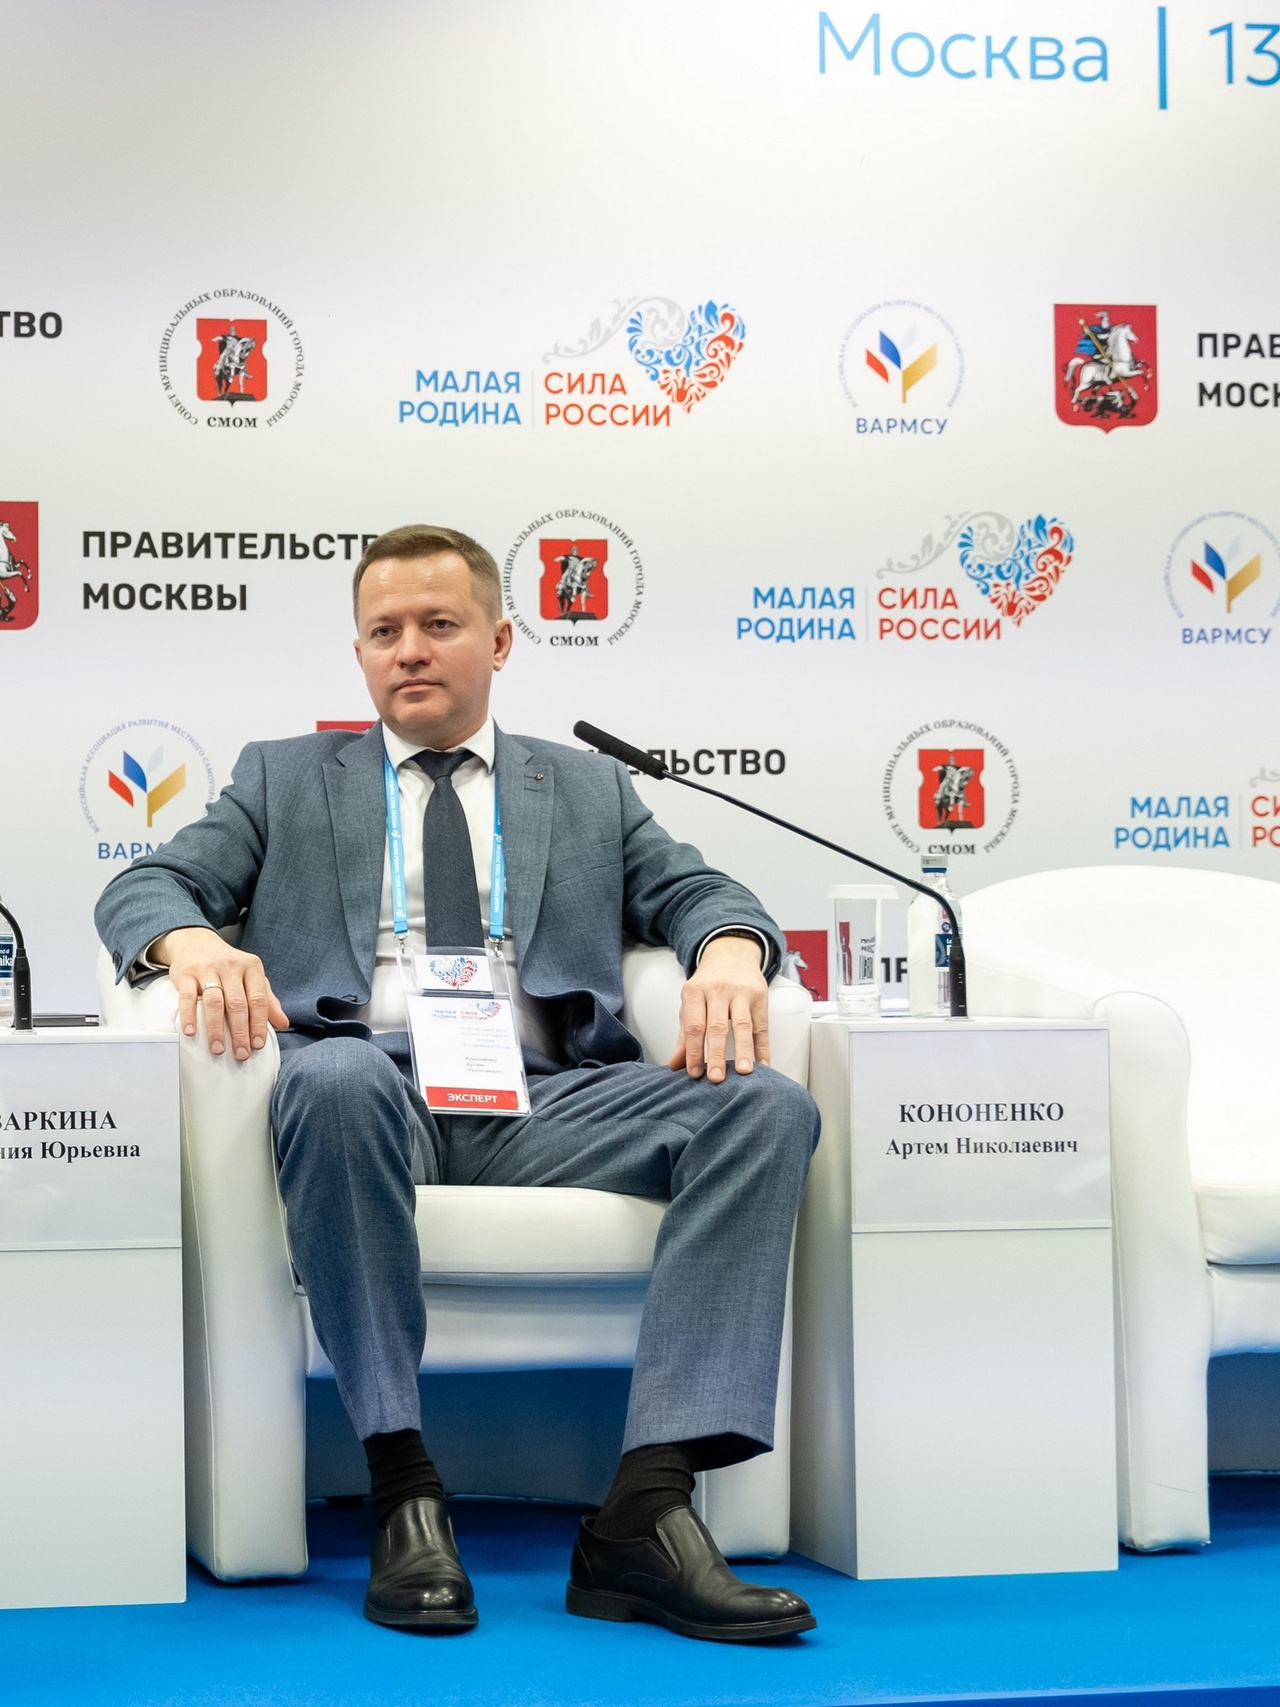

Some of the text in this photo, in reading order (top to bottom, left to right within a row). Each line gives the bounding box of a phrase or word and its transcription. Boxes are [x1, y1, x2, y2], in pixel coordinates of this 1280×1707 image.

[818, 11, 1109, 83] Москва
[1208, 22, 1280, 87] 13
[159, 288, 305, 427] СОВЕТ МУНИЦИПАЛЬНЫХ ОБРАЗОВАНИЙ ГОРОДА МОСКВЫ
[416, 369, 521, 394] МАЛАЯ
[543, 371, 627, 396] СИЛА
[206, 416, 258, 428] СМОМ
[399, 400, 522, 427] РОДИНА
[545, 402, 671, 427] РОССИИ
[855, 417, 948, 434] ВАРМСУ
[555, 509, 634, 550] ОБРАЗОВАНИЙ
[629, 549, 645, 597] ГОРОДА
[82, 582, 247, 611] МОСКВЫ
[753, 586, 855, 609] МАЛАЯ
[877, 586, 959, 610] СИЛА
[511, 613, 542, 645] СОВЕТ
[606, 599, 643, 645] МОСКВЫ
[737, 617, 856, 643] РОДИНА
[879, 617, 1001, 641] РОССИИ
[549, 635, 600, 647] СМОМ
[1181, 628, 1271, 644] ВАРМСУ
[1130, 796, 1229, 819] МАЛАЯ
[927, 843, 976, 855] СМОМ
[1115, 827, 1230, 852] РОДИНА
[446, 1092, 499, 1104] ЭКСПЕРТ
[898, 1102, 1065, 1123] КОНОНЕНКО
[40, 1140, 141, 1164] Юрьевна
[885, 1136, 1079, 1160] Артем Николаевич
